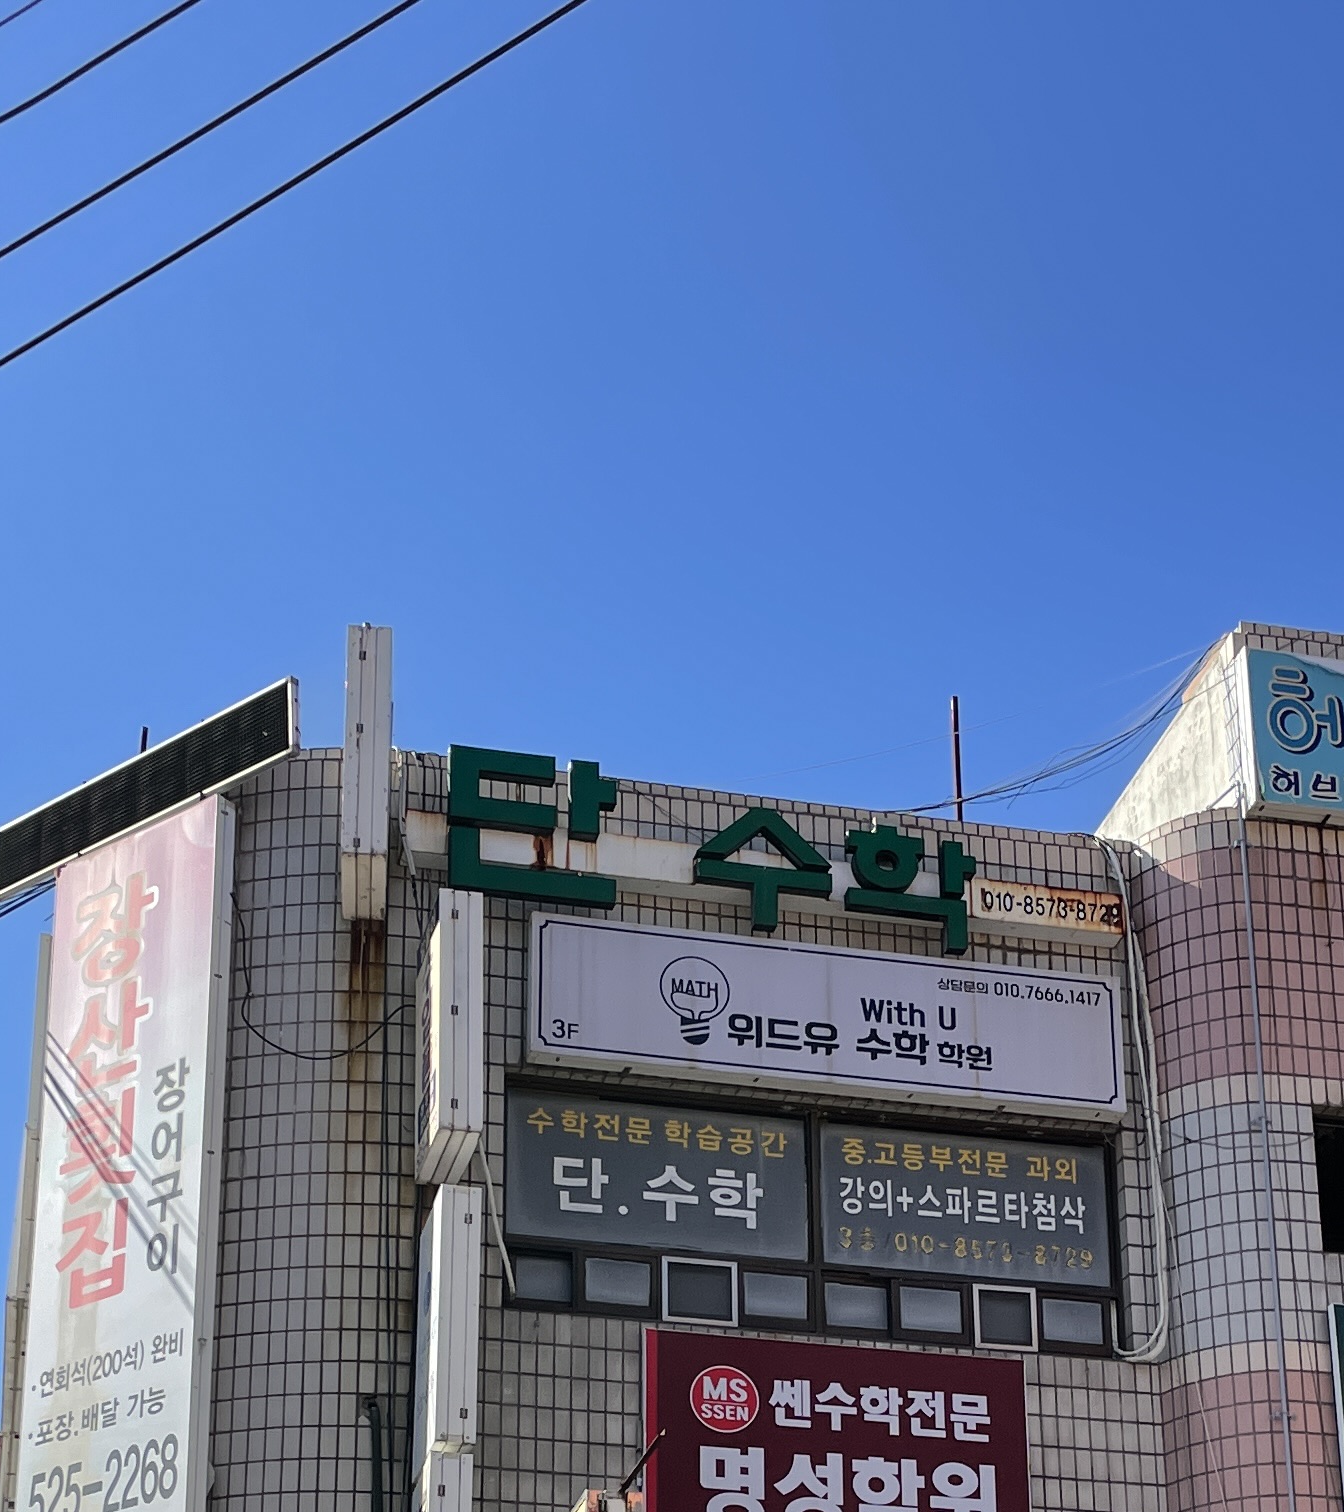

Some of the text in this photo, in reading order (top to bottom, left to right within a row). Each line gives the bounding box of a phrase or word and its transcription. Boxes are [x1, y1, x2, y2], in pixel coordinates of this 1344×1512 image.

[693, 806, 976, 954] 수학
[671, 976, 720, 1002] MATH
[937, 977, 1101, 1007] 상담문의 010.7666.1417
[552, 1018, 579, 1040] 3F
[860, 998, 957, 1031] With U
[727, 1013, 994, 1072] 위드유 수학 학원
[527, 1107, 788, 1159] 수학전문 학습공간
[146, 1057, 190, 1275] 장어구이
[1026, 1155, 1078, 1186] 과외
[838, 1176, 1086, 1236] 강의+스파르타첨삭
[701, 1403, 749, 1424] SSEN
[770, 1378, 991, 1443] 쎈수학전문
